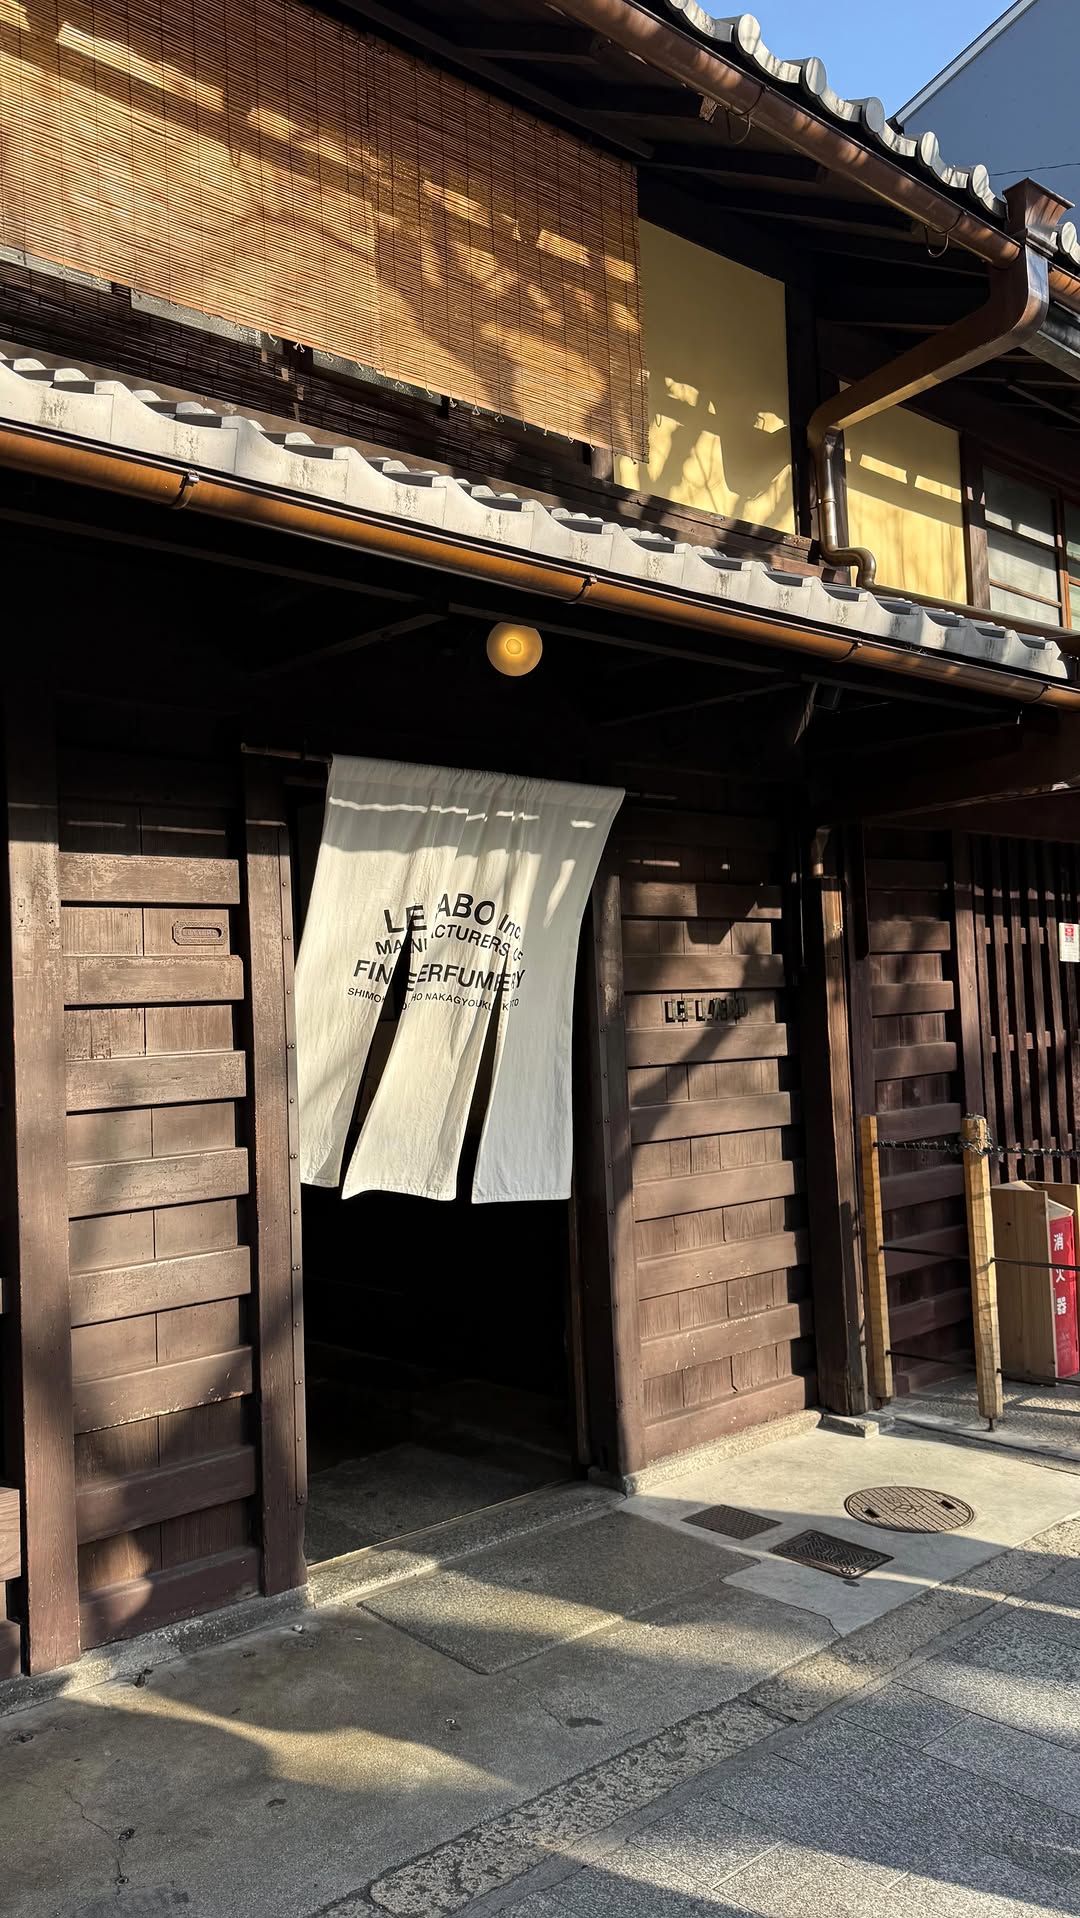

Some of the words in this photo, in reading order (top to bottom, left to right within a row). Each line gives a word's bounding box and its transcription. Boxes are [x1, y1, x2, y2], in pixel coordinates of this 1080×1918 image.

[383, 904, 428, 934] LE
[434, 893, 496, 926] ABO
[416, 963, 526, 992] ERFUMERY
[1053, 1232, 1067, 1316] 消火器
